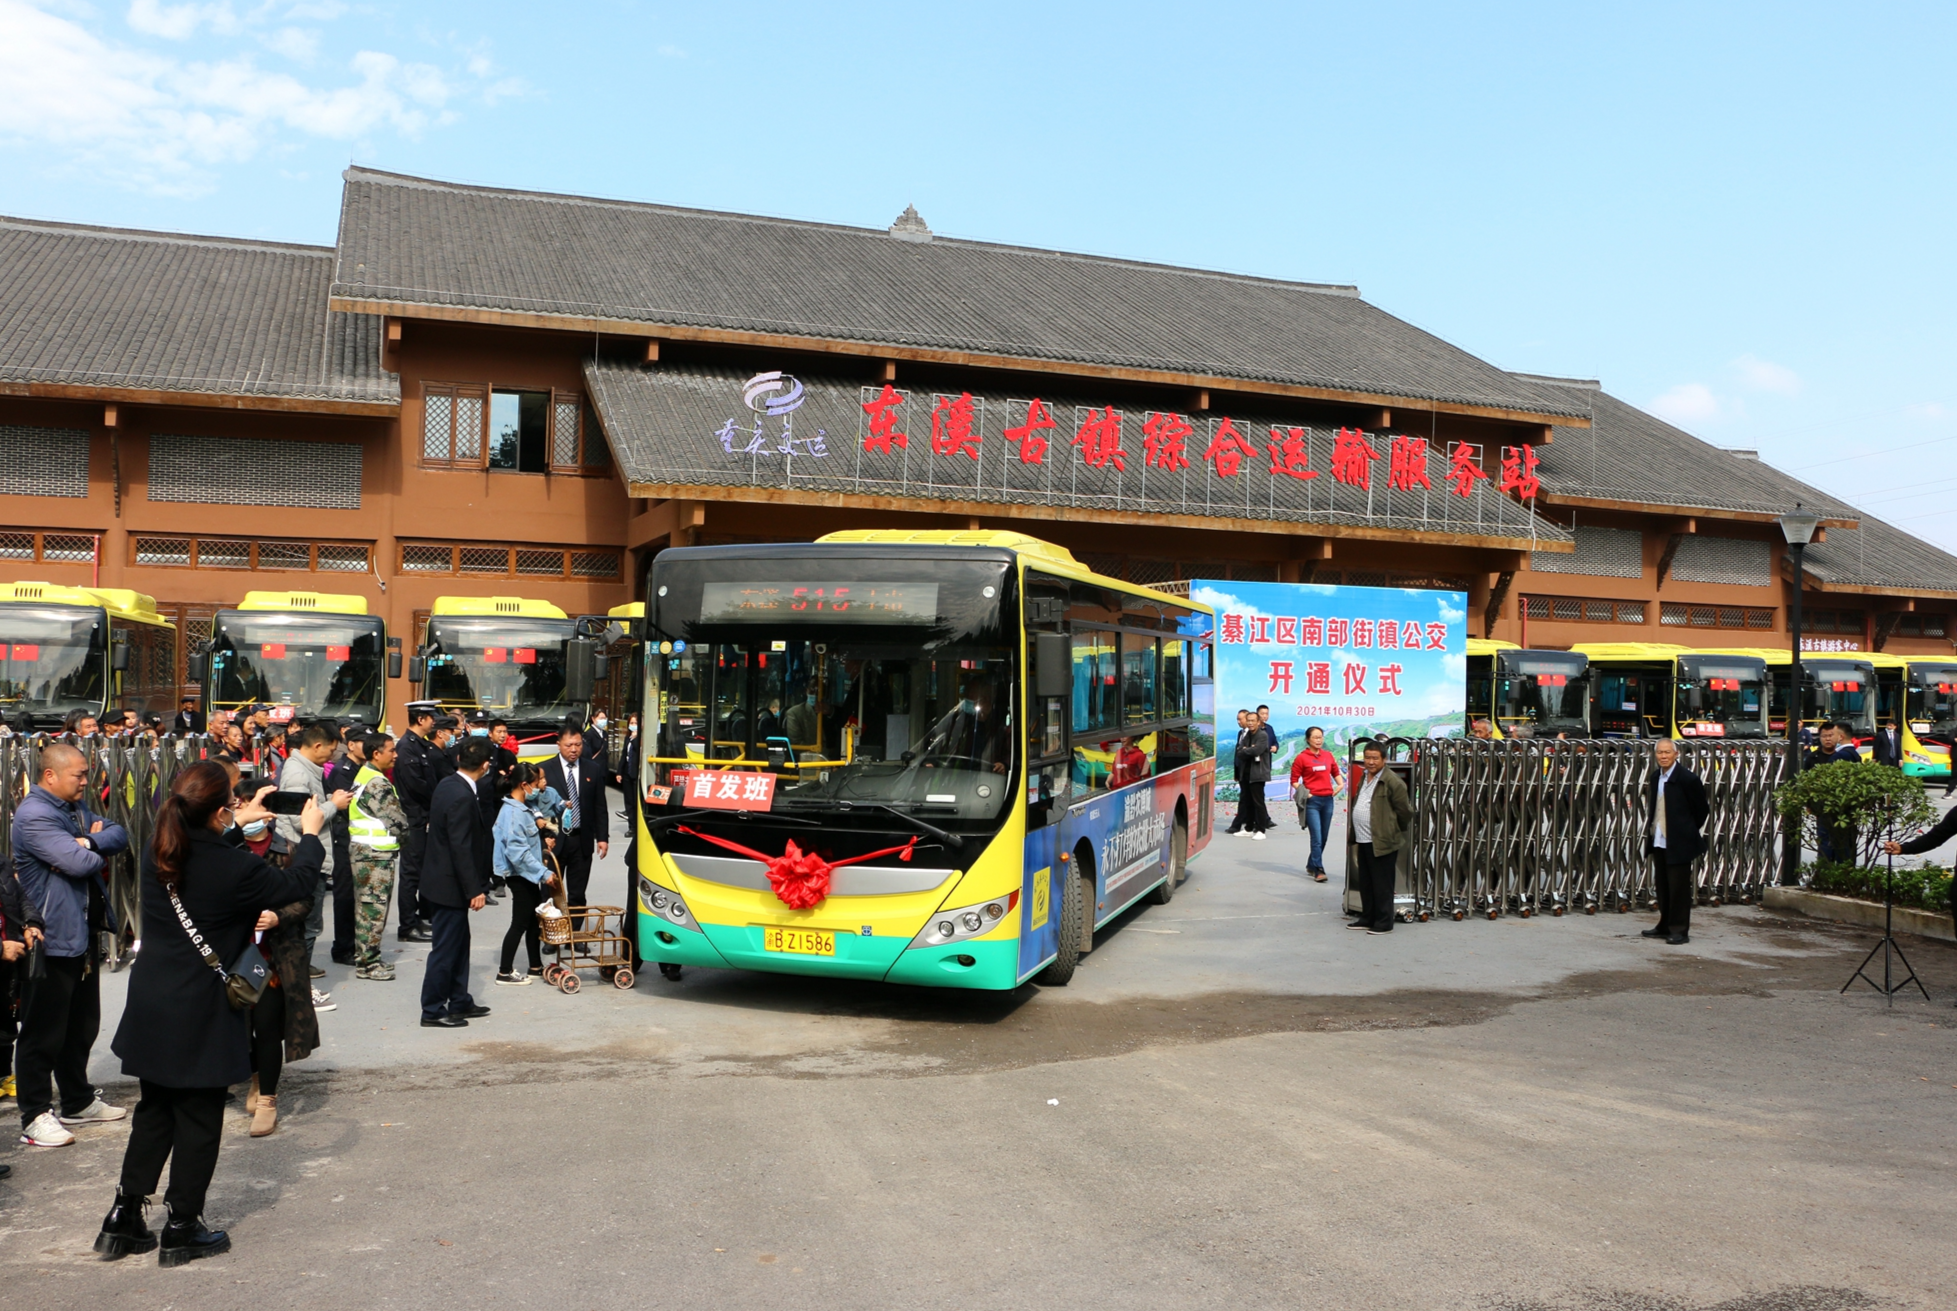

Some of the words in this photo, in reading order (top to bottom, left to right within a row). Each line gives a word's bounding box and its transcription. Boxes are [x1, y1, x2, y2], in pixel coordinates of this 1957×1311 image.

[862, 384, 1540, 499] 东溪古镇综合运输服务站
[791, 587, 849, 611] 515
[1221, 613, 1448, 651] 綦江区南部街镇公交
[1268, 660, 1403, 696] 开通仪式
[1296, 705, 1376, 717] 2021年10月30日
[693, 773, 770, 801] 首发班
